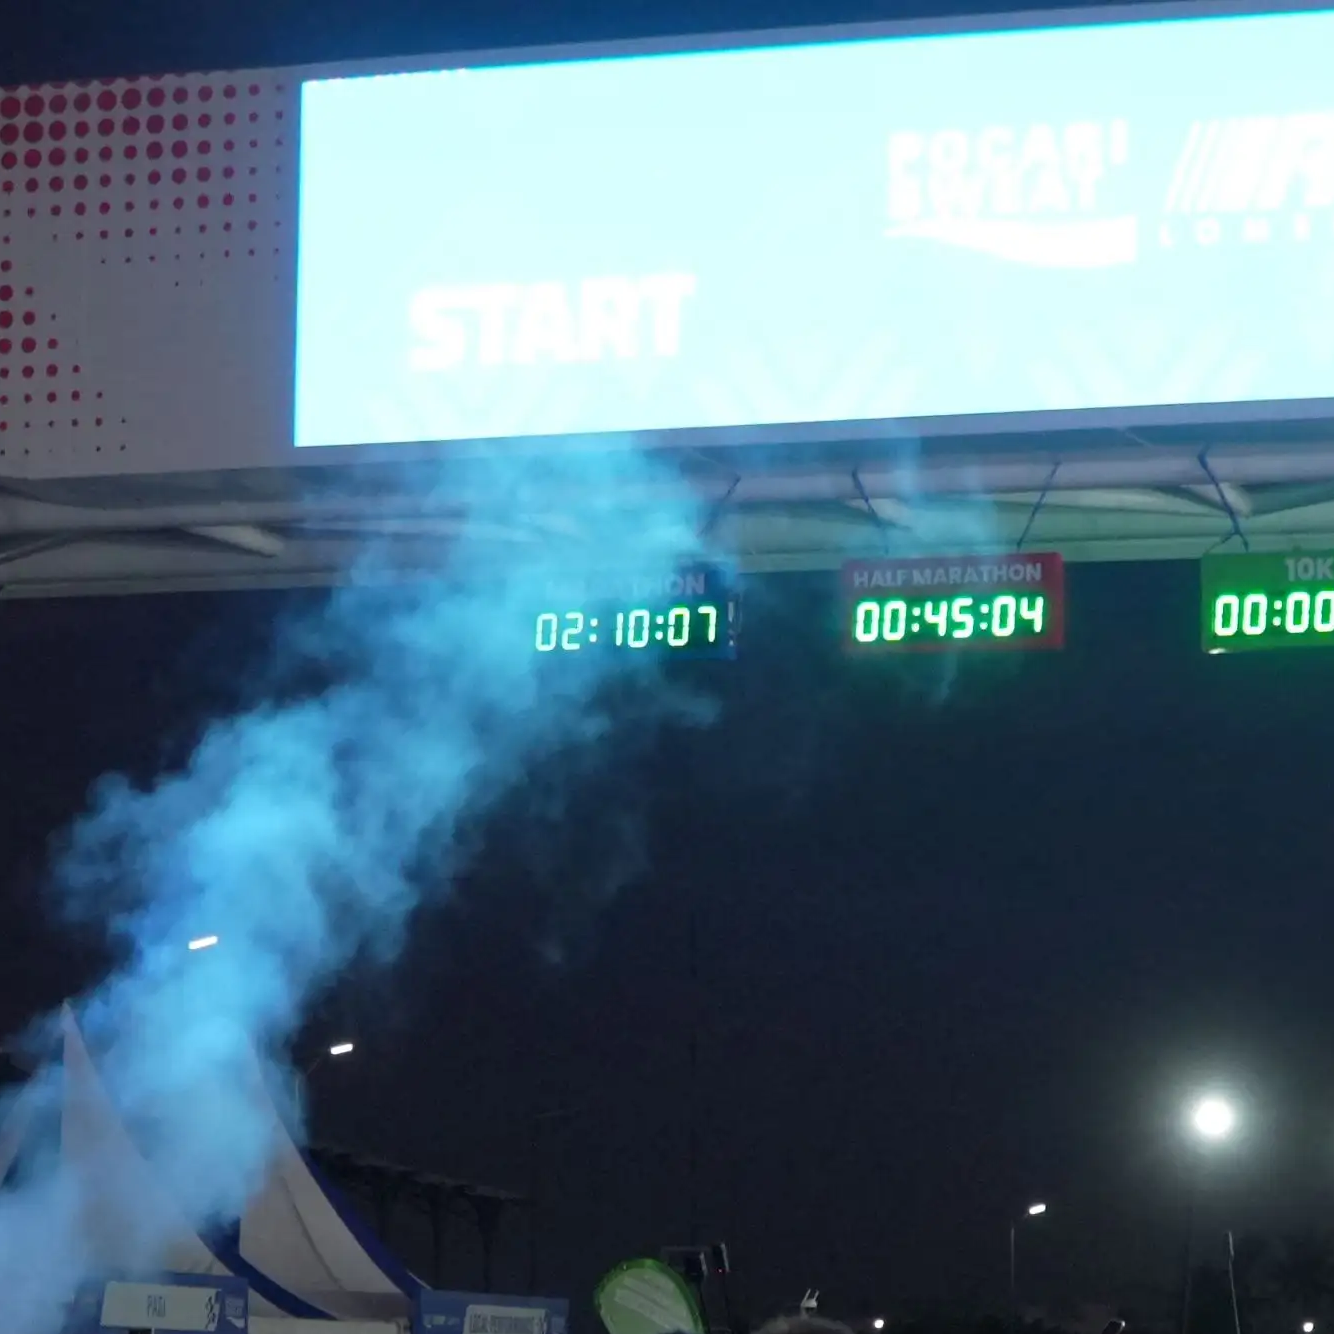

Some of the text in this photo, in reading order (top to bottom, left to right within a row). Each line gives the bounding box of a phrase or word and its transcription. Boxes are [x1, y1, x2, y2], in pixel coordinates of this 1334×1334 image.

[408, 272, 697, 373] START
[853, 563, 1042, 588] HALF MARATHON
[1284, 557, 1334, 581] 10K
[855, 595, 1044, 642] 00:45:04
